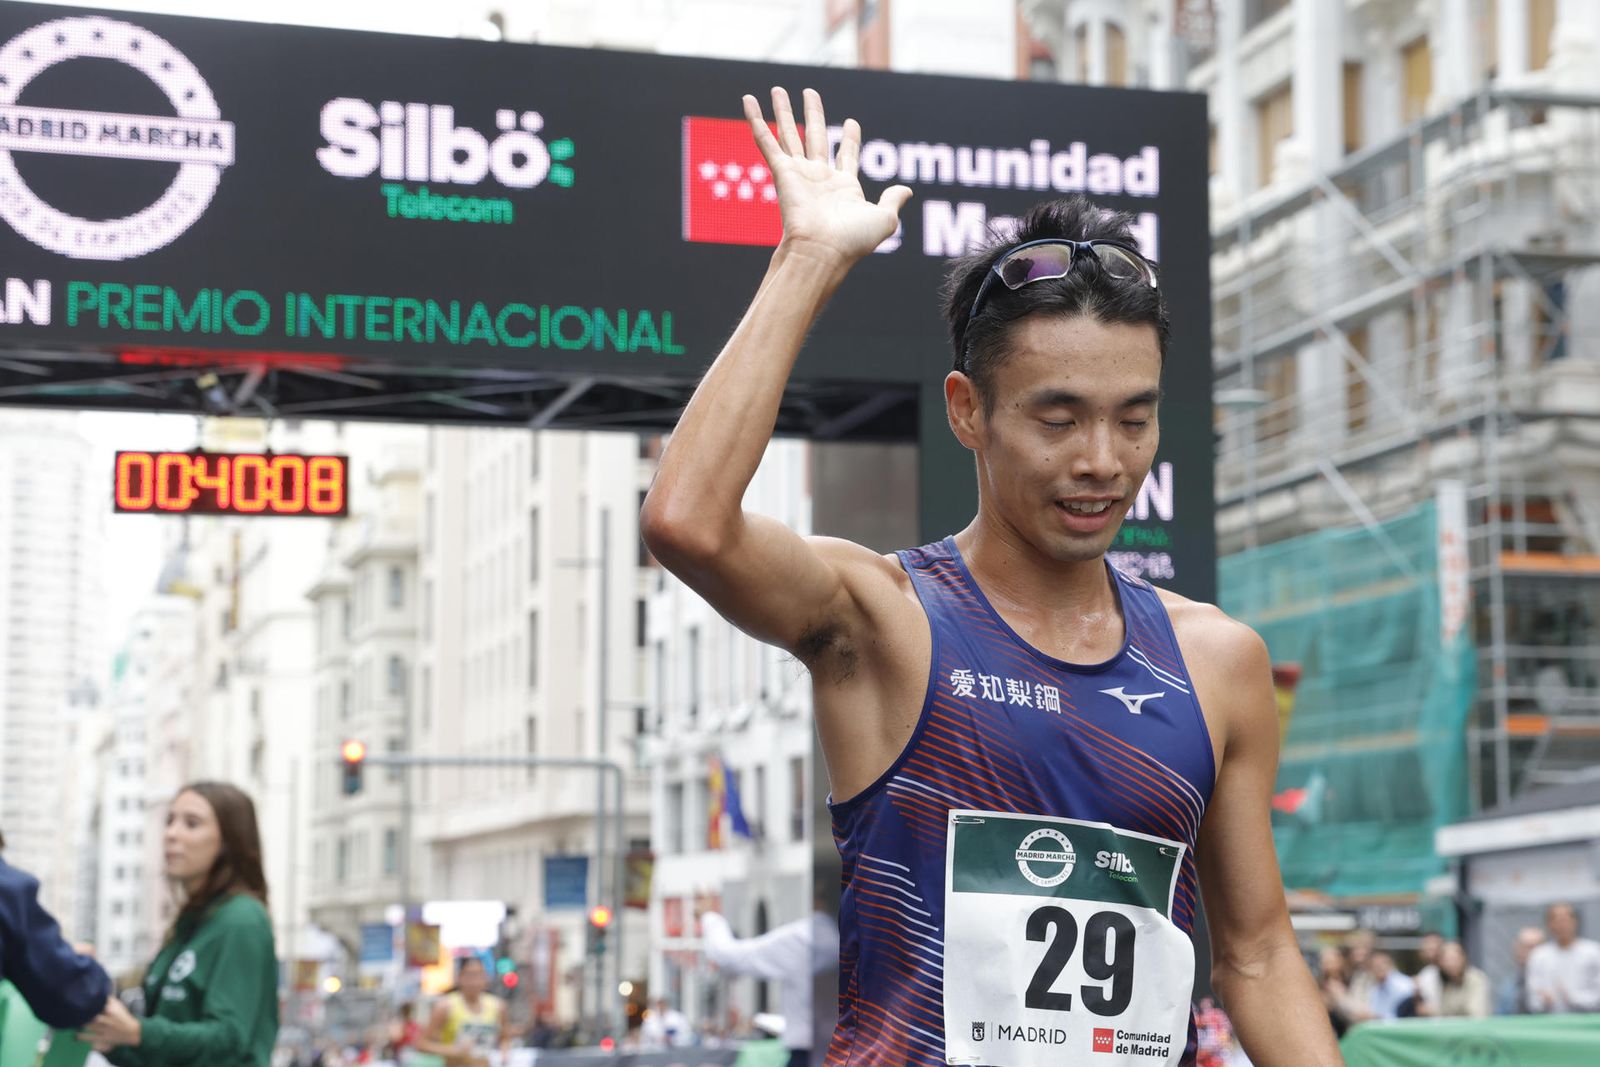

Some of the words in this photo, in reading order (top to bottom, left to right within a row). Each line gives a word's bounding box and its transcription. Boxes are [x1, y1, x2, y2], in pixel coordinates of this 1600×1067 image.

[381, 184, 514, 224] Telecom
[66, 280, 271, 336] PREMIO
[285, 292, 686, 355] INTERNACIONAL
[116, 452, 344, 513] 00:40:08
[950, 668, 1062, 714] 愛知製鋼
[1016, 851, 1045, 859] MADRID
[1046, 853, 1075, 861] MARCHA
[1025, 905, 1136, 1017] 29
[998, 1024, 1067, 1045] MADRID
[1115, 1043, 1128, 1055] de
[1130, 1044, 1169, 1058] Madrid
[1116, 1029, 1171, 1044] Comunidad
